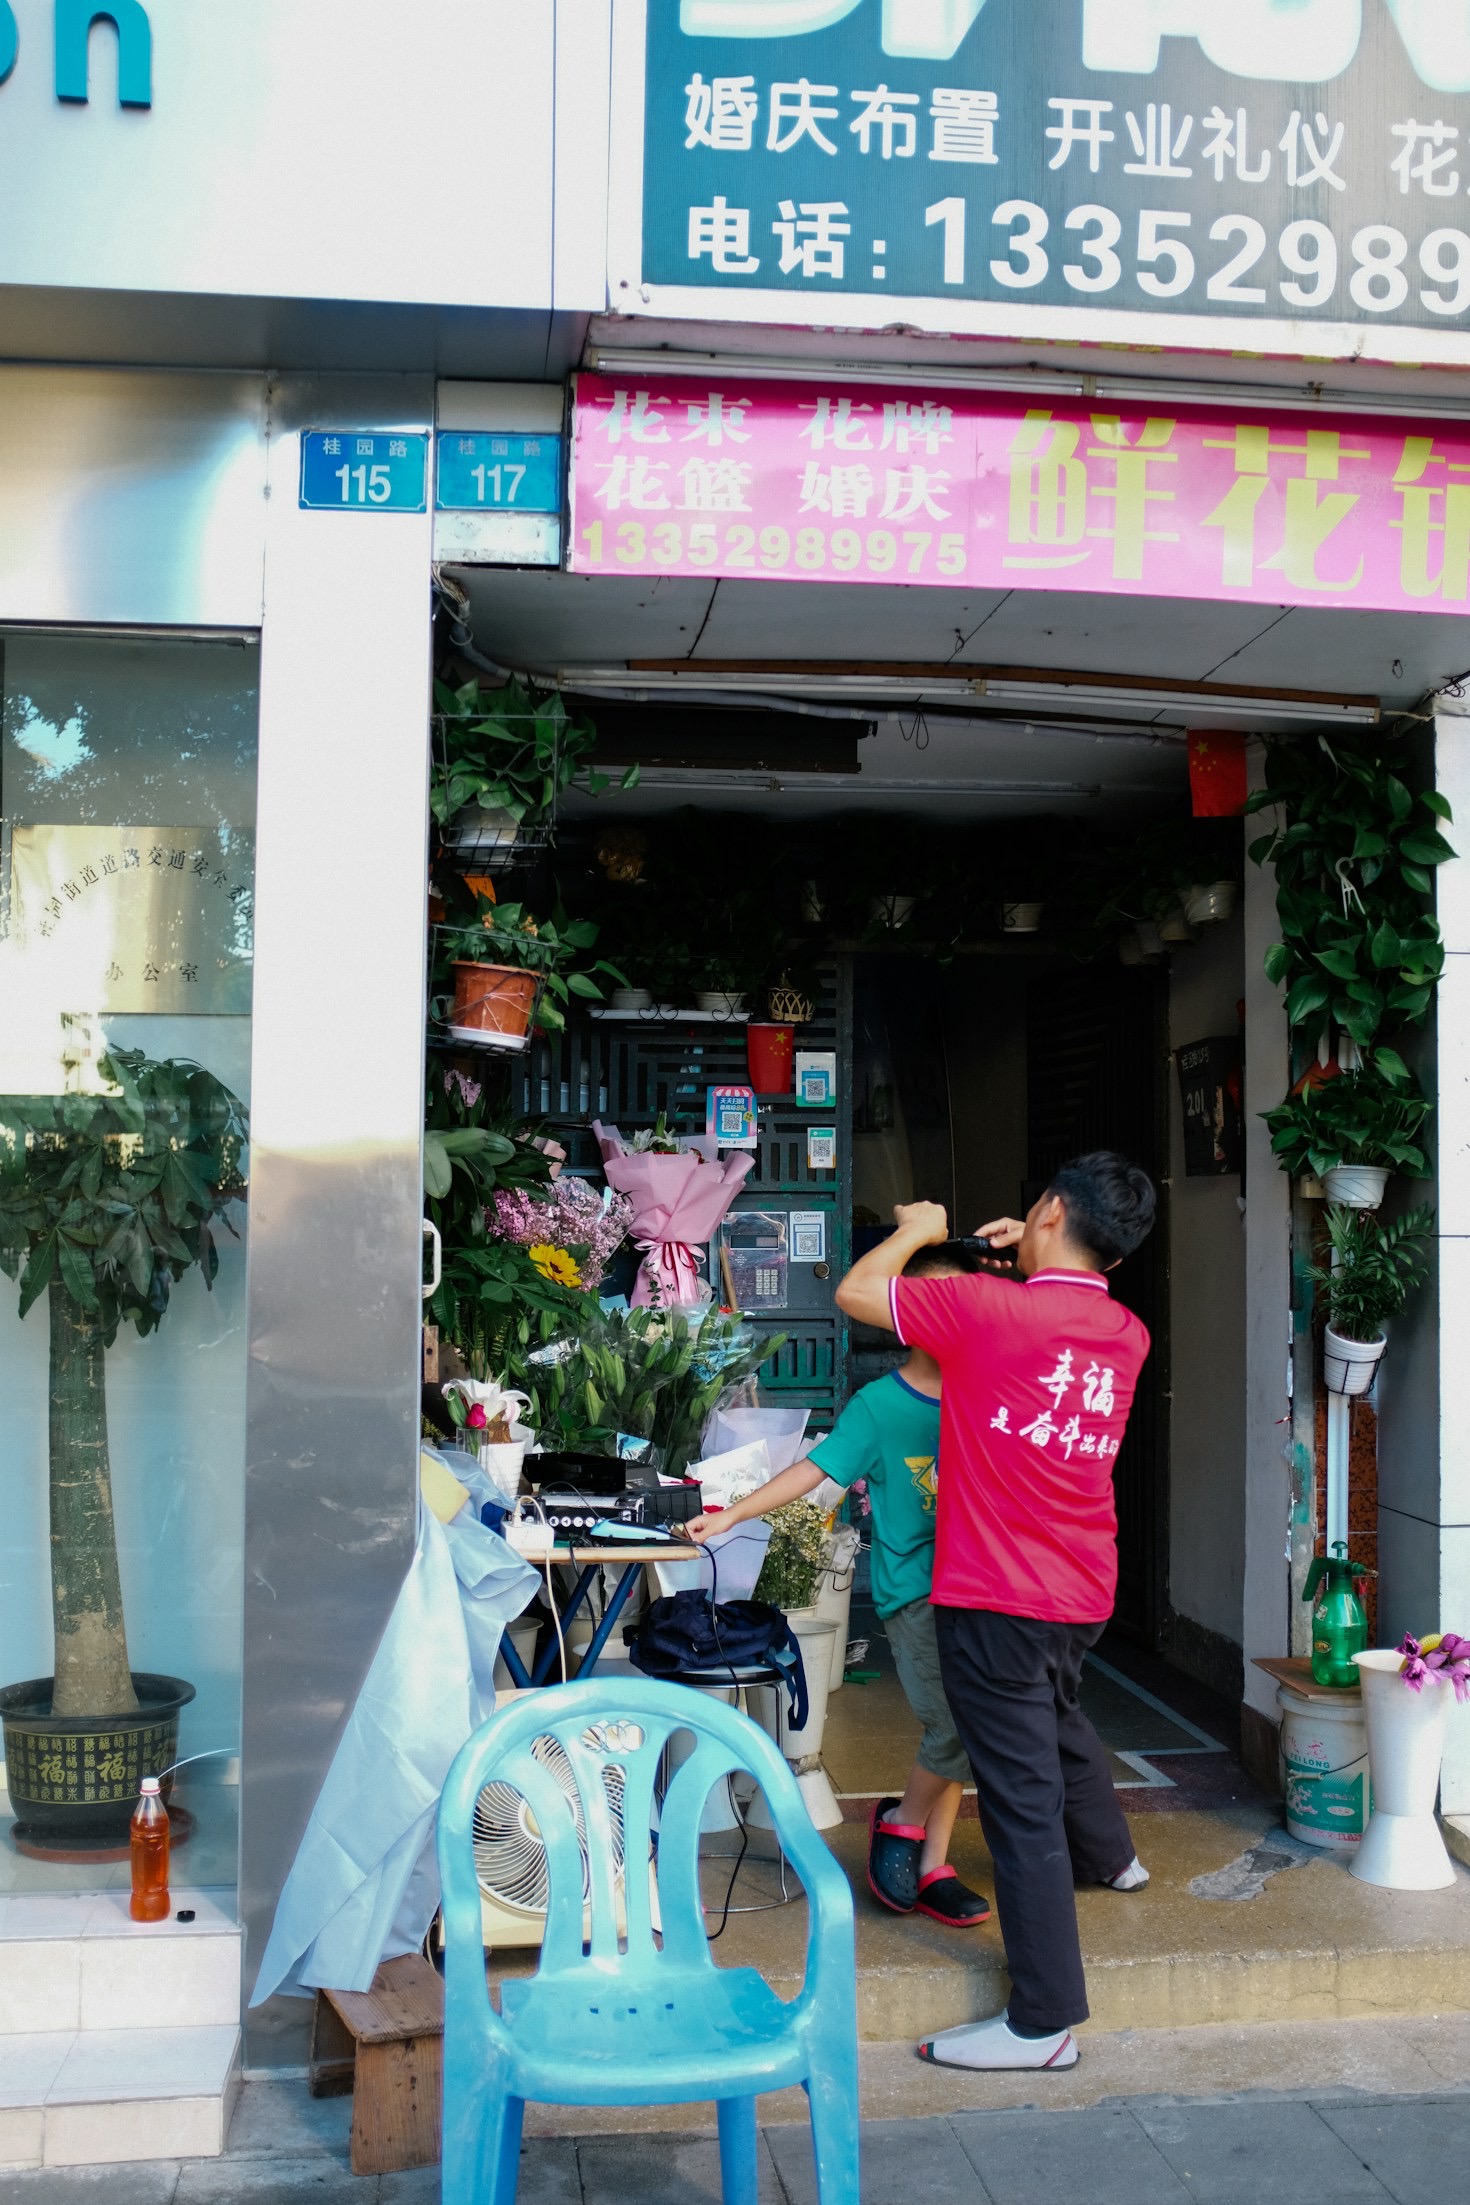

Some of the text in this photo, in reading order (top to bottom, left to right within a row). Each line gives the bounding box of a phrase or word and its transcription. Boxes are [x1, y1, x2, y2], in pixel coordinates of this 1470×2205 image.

[0, 0, 152, 109] n
[684, 73, 1470, 197] 婚庆布置 开业礼仪 花
[595, 390, 955, 454] 花束 花牌
[322, 437, 408, 458] 桂园路
[458, 438, 541, 457] 桂园路
[335, 463, 391, 503] 115
[471, 463, 527, 502] 117
[593, 455, 953, 522] 花篮 婚庆
[582, 520, 968, 576] 13352989975
[1037, 1348, 1115, 1418] 幸福
[38, 1753, 66, 1784] 福
[96, 1751, 127, 1783] 福
